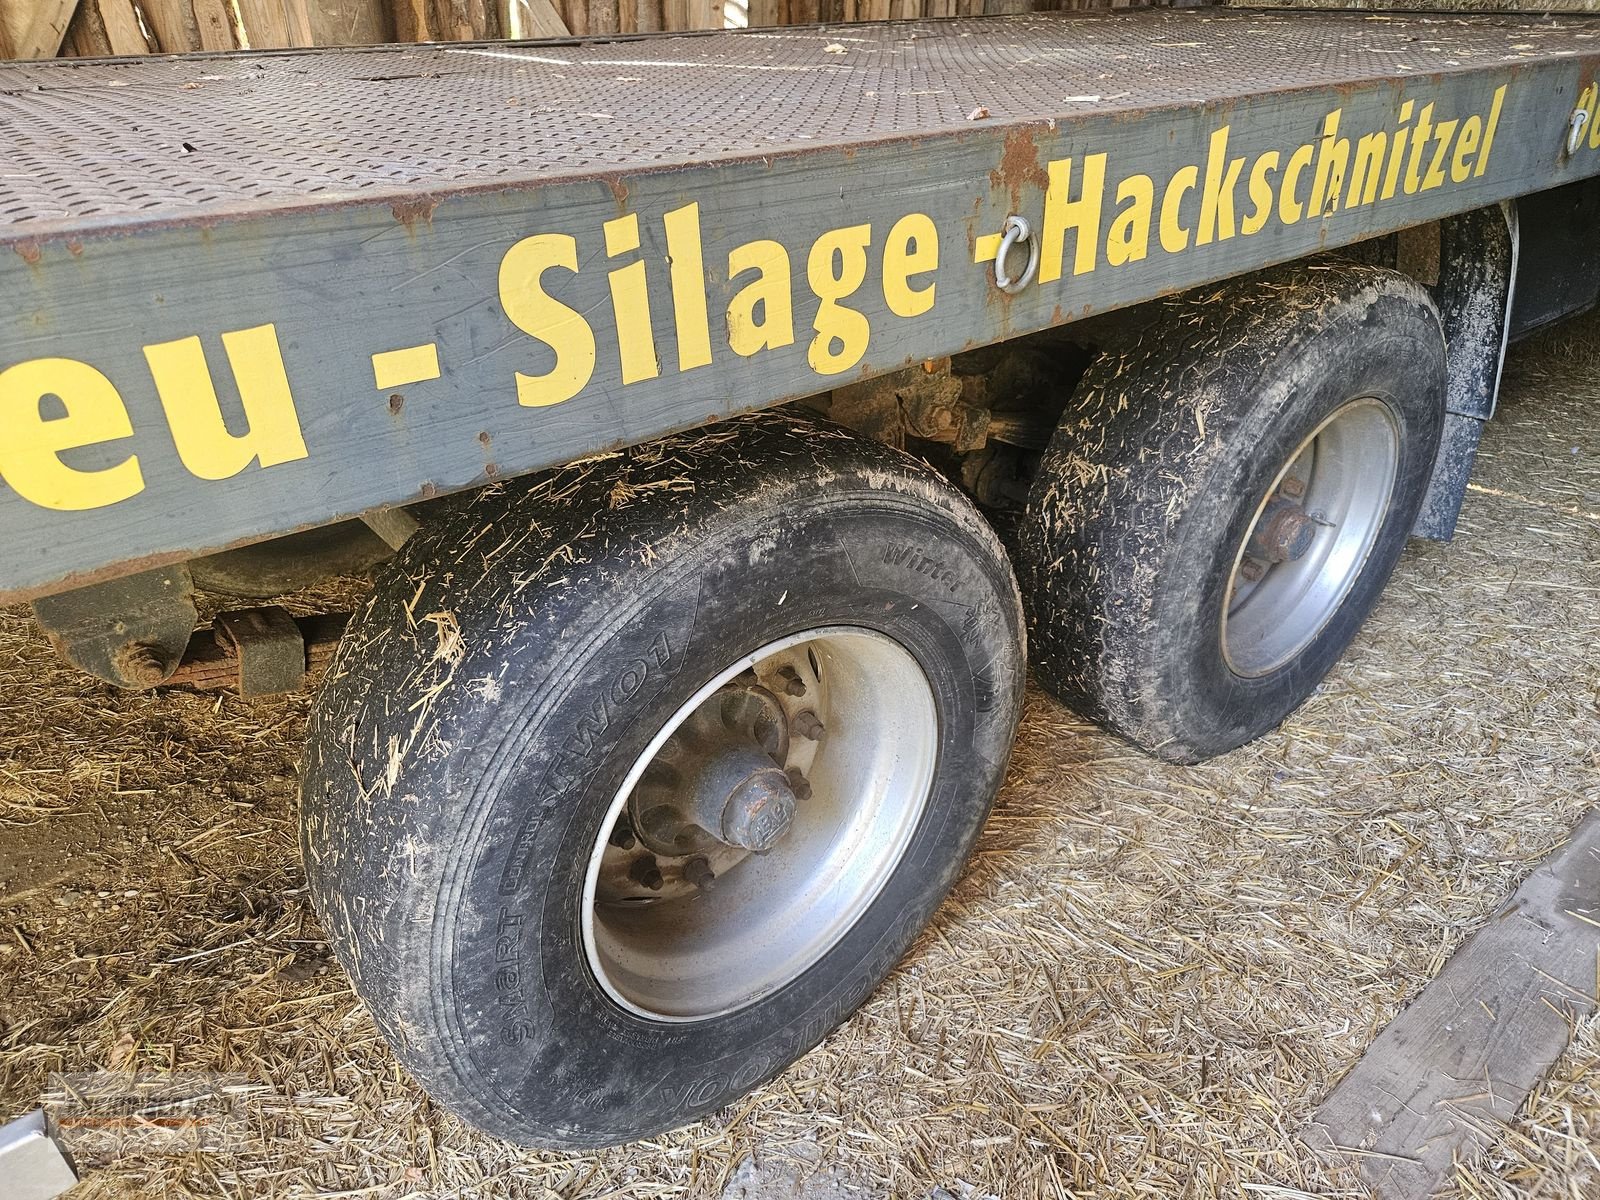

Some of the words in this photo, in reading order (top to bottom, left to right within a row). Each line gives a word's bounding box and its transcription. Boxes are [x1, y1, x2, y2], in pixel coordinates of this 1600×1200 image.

[498, 202, 940, 406] Silage
[1037, 84, 1508, 286] Hackschnitzel
[881, 541, 967, 593] Winter
